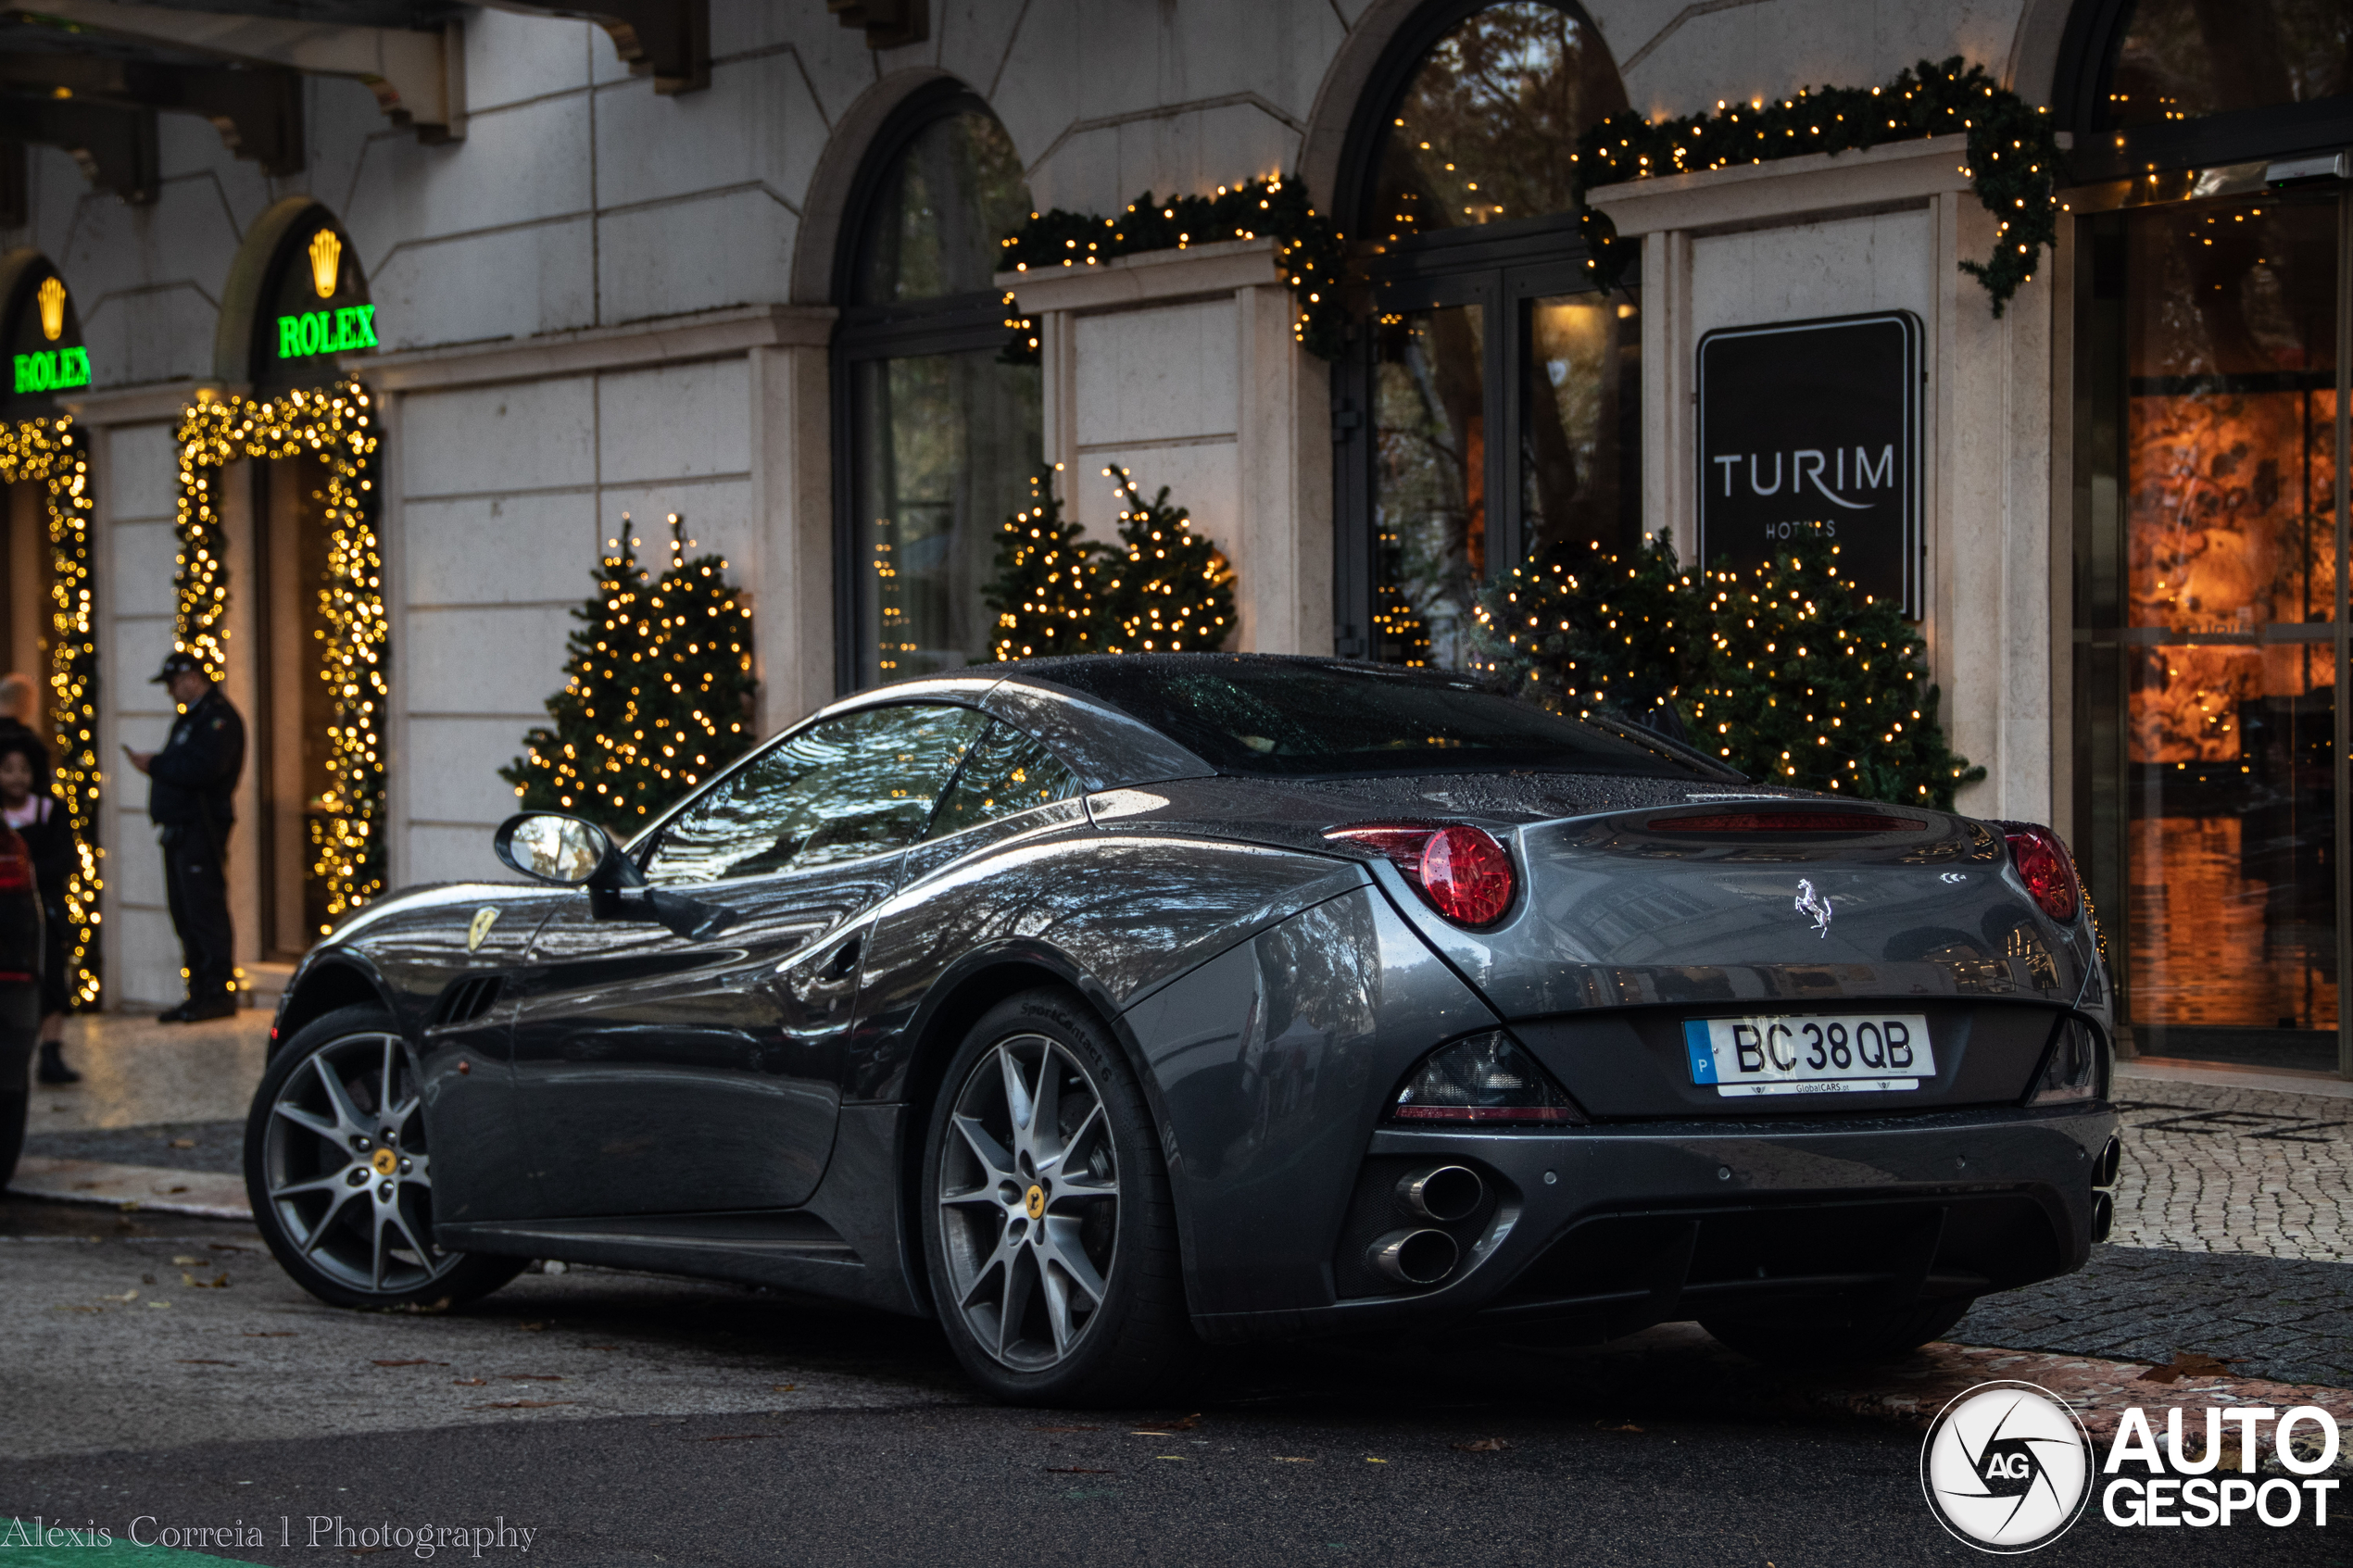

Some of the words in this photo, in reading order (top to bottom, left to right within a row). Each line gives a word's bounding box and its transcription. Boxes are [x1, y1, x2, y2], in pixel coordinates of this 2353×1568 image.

[278, 304, 378, 358] ROLEX
[1714, 444, 1894, 508] TURIM
[1766, 519, 1835, 539] HOTLS
[1732, 1022, 1797, 1073] BC
[1802, 1022, 1852, 1071] 38
[1856, 1021, 1914, 1069] QB
[1698, 1059, 1708, 1073] P
[1795, 1083, 1850, 1093] GlobalCARS.pt
